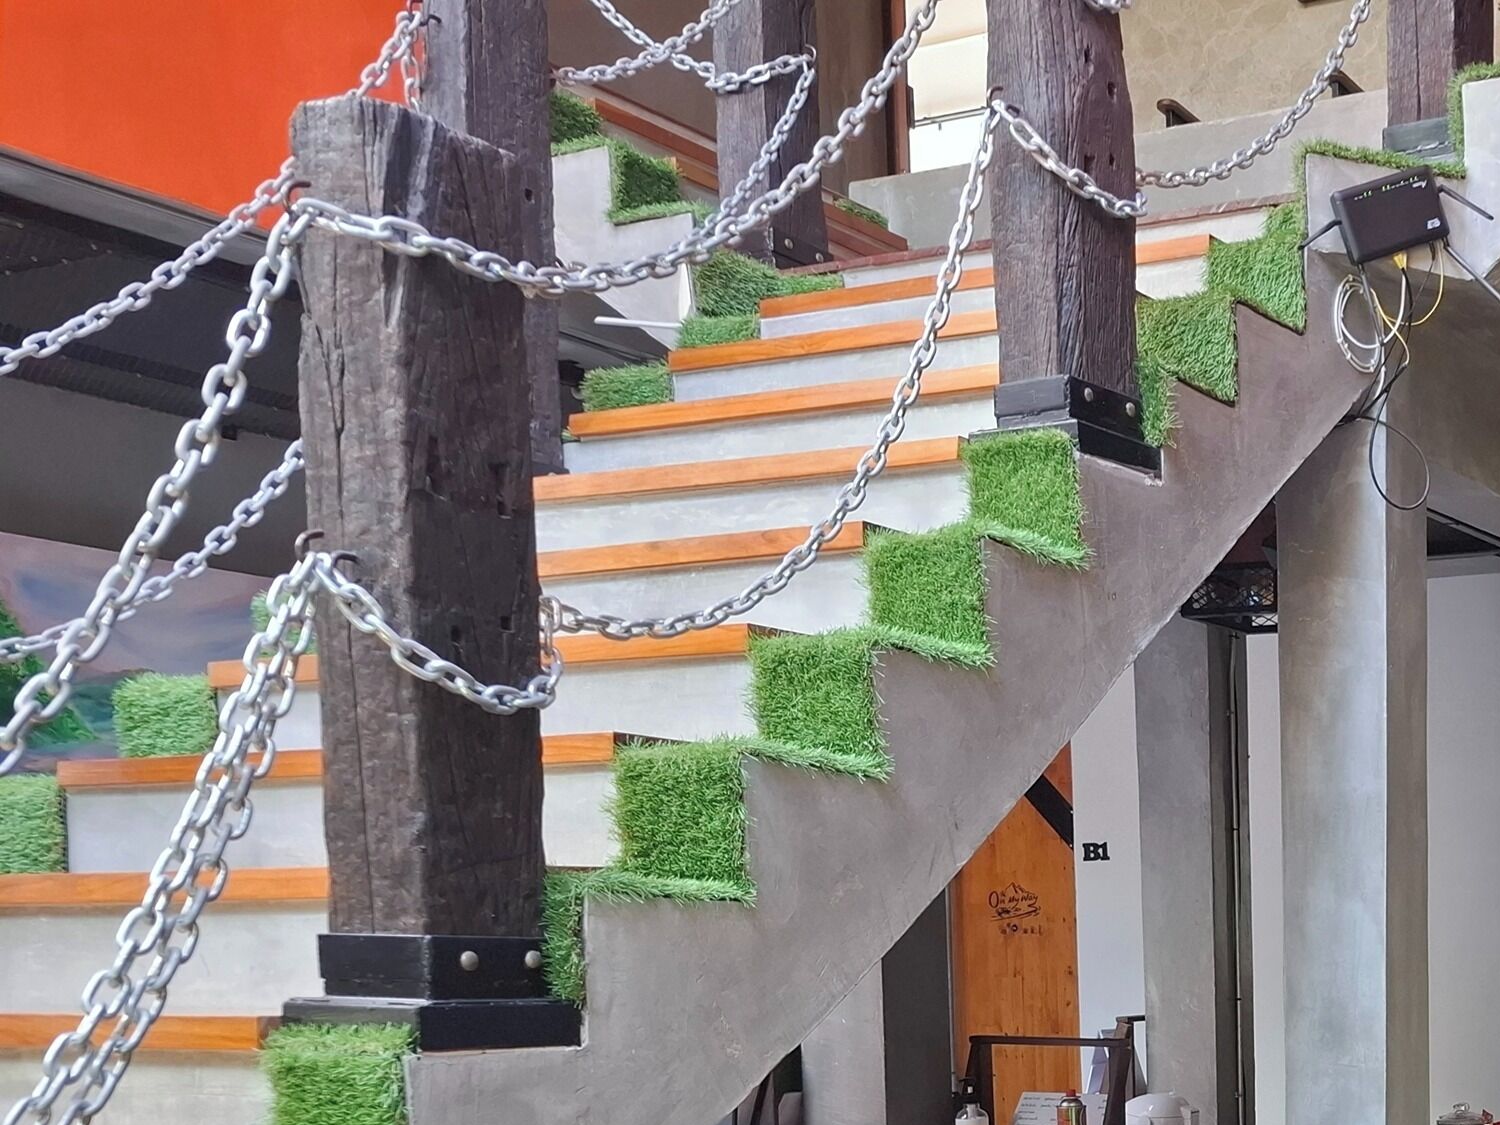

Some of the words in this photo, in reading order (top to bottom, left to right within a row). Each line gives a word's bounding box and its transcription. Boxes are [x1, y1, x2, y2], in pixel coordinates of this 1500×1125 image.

[1082, 842, 1110, 862] B1
[989, 891, 1005, 908] On
[1008, 895, 1019, 909] My
[1021, 893, 1038, 904] Way
